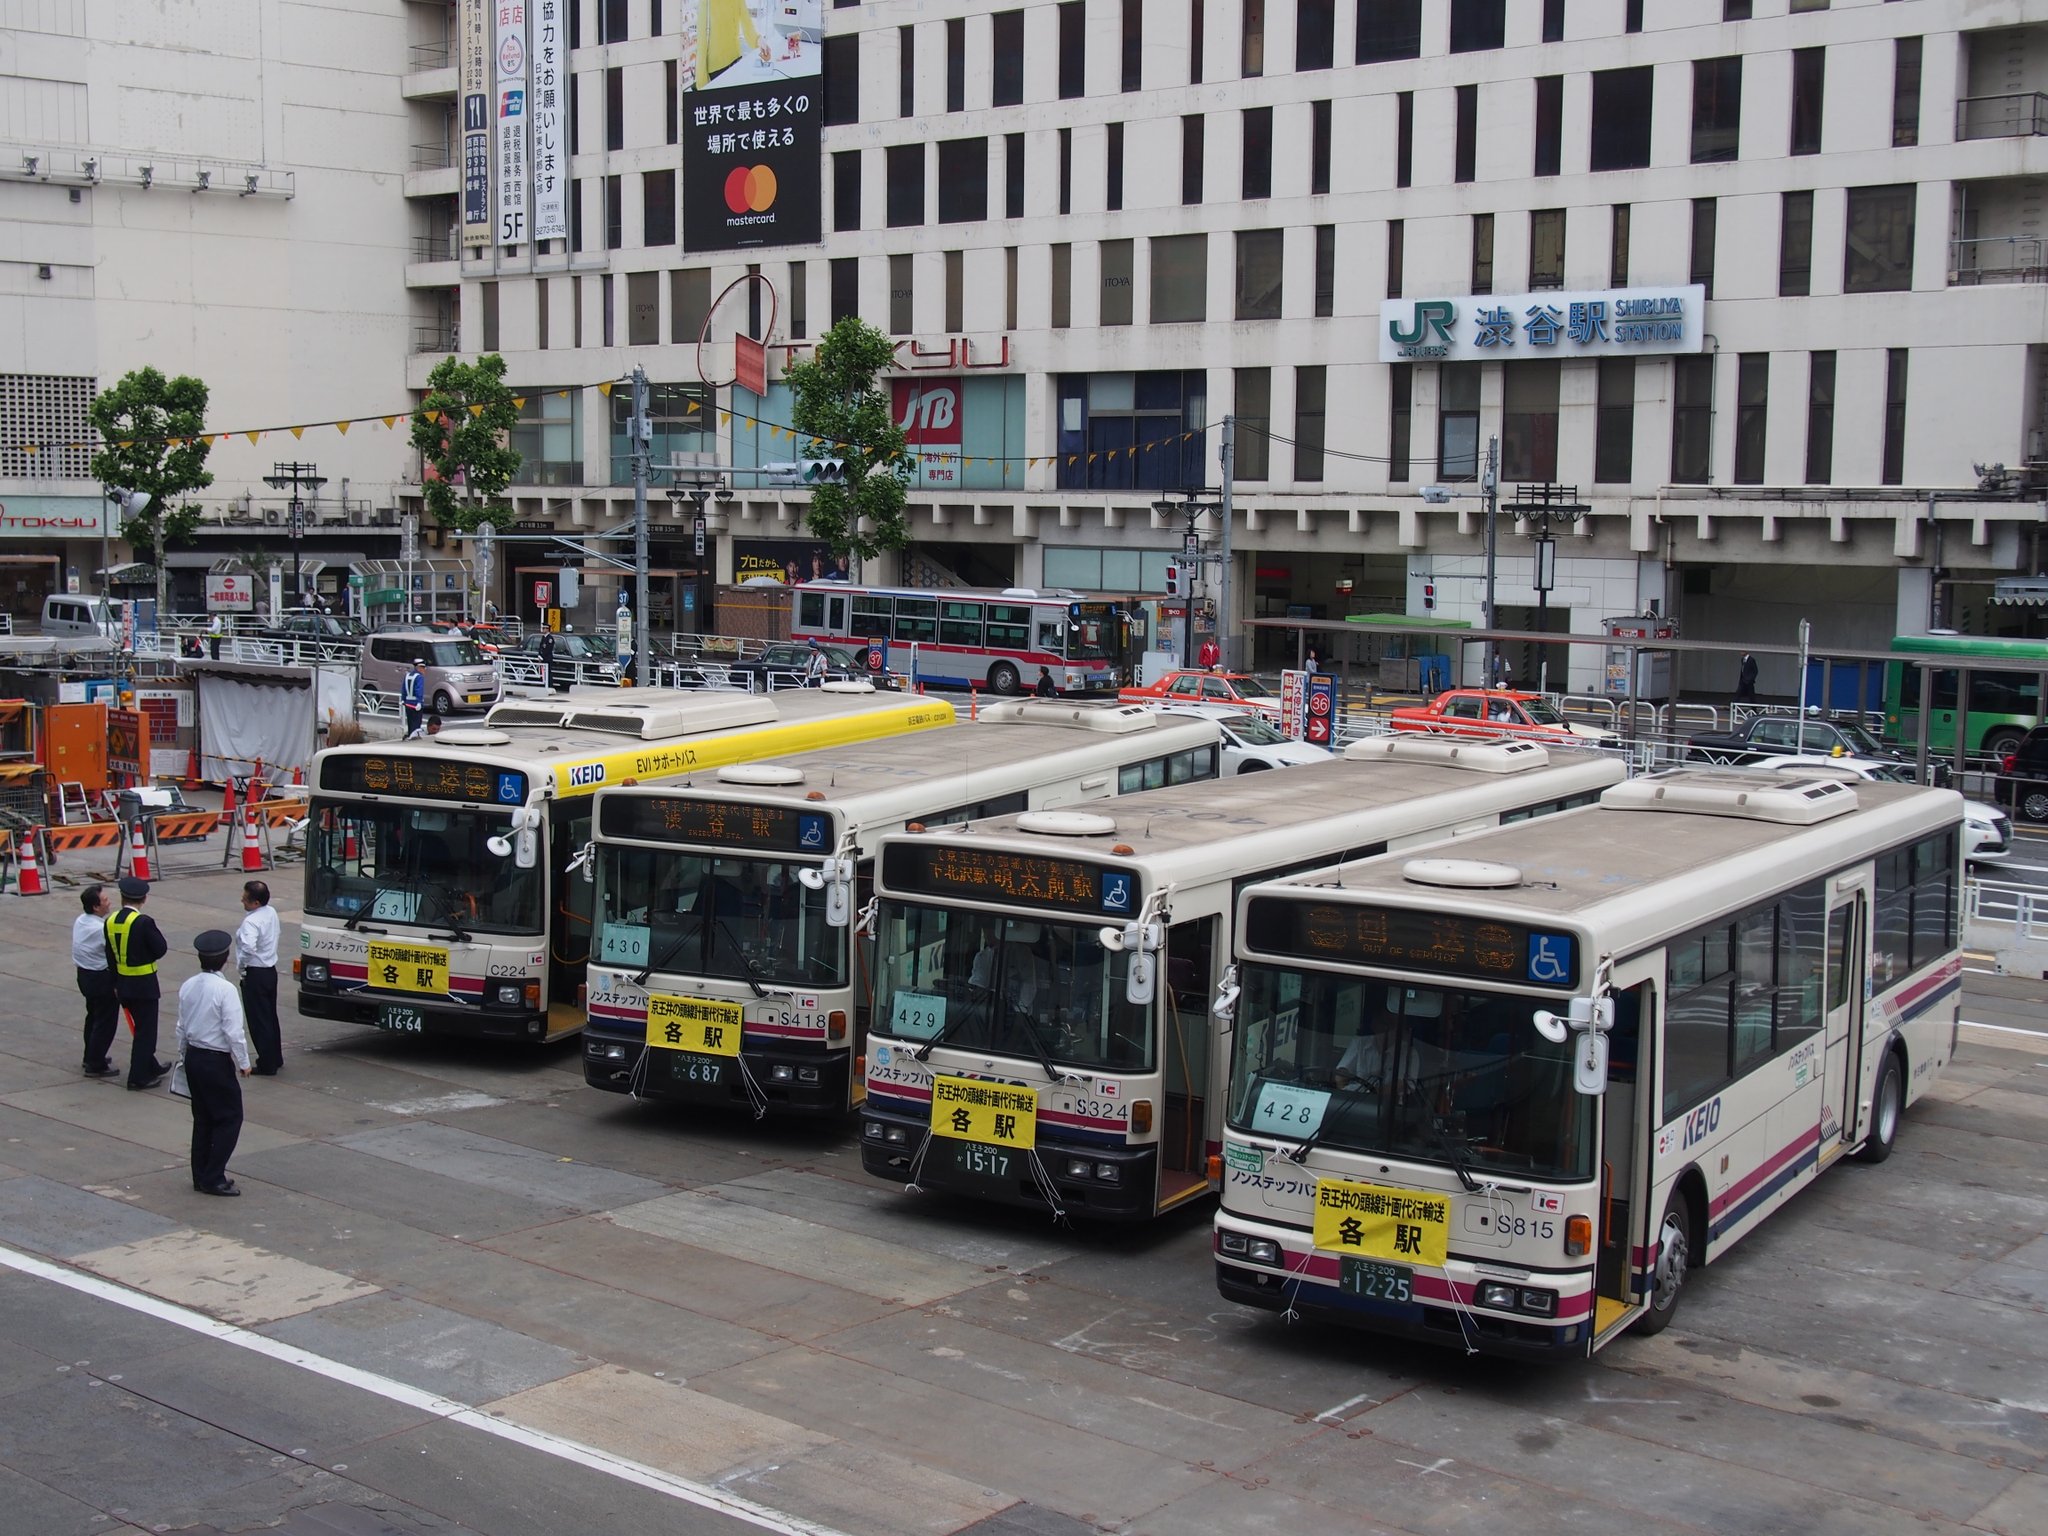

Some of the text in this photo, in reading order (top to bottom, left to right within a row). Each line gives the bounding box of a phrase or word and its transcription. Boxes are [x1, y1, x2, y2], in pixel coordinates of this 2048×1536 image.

[542, 1, 555, 193] 協力をお願いします
[694, 95, 809, 127] 世界で最も多くの
[707, 127, 794, 154] 場所で使える
[503, 213, 523, 239] 5F
[727, 213, 775, 226] mastercard
[1104, 277, 1130, 288] ITO-YA
[1615, 298, 1682, 317] SHIBUYA
[1389, 301, 1456, 343] JR
[1474, 300, 1609, 347] 渋谷駅
[1615, 322, 1682, 343] STATION
[768, 336, 1009, 372] TKYU
[898, 388, 956, 430] JTB
[928, 470, 954, 481] 専門店
[3, 517, 97, 528] TOKYU
[740, 554, 780, 569] プロだから、
[619, 592, 627, 603] 37
[870, 654, 881, 665] 37
[1312, 696, 1328, 711] 36
[636, 749, 697, 773] EVI サポートバス
[570, 763, 605, 786] KEIO
[370, 945, 447, 967] 京王井の頭線計画代行輸送
[607, 939, 641, 955] 430
[490, 964, 527, 978] C224
[590, 991, 650, 1008] ノンステップバ
[651, 1000, 739, 1025] 京王井の頭線計画代行輸送
[781, 1012, 826, 1028] S418
[899, 1009, 935, 1027] 429
[869, 1064, 934, 1086] ノンステップバ
[937, 1083, 1034, 1113] 京王井の頭線計画代行輸送
[1077, 1099, 1128, 1119] S324
[1264, 1102, 1311, 1124] 428
[1683, 1097, 1721, 1151] KEIO
[1319, 1186, 1445, 1224] 京王井の頭線計画代行輸送
[1497, 1215, 1554, 1239] S815
